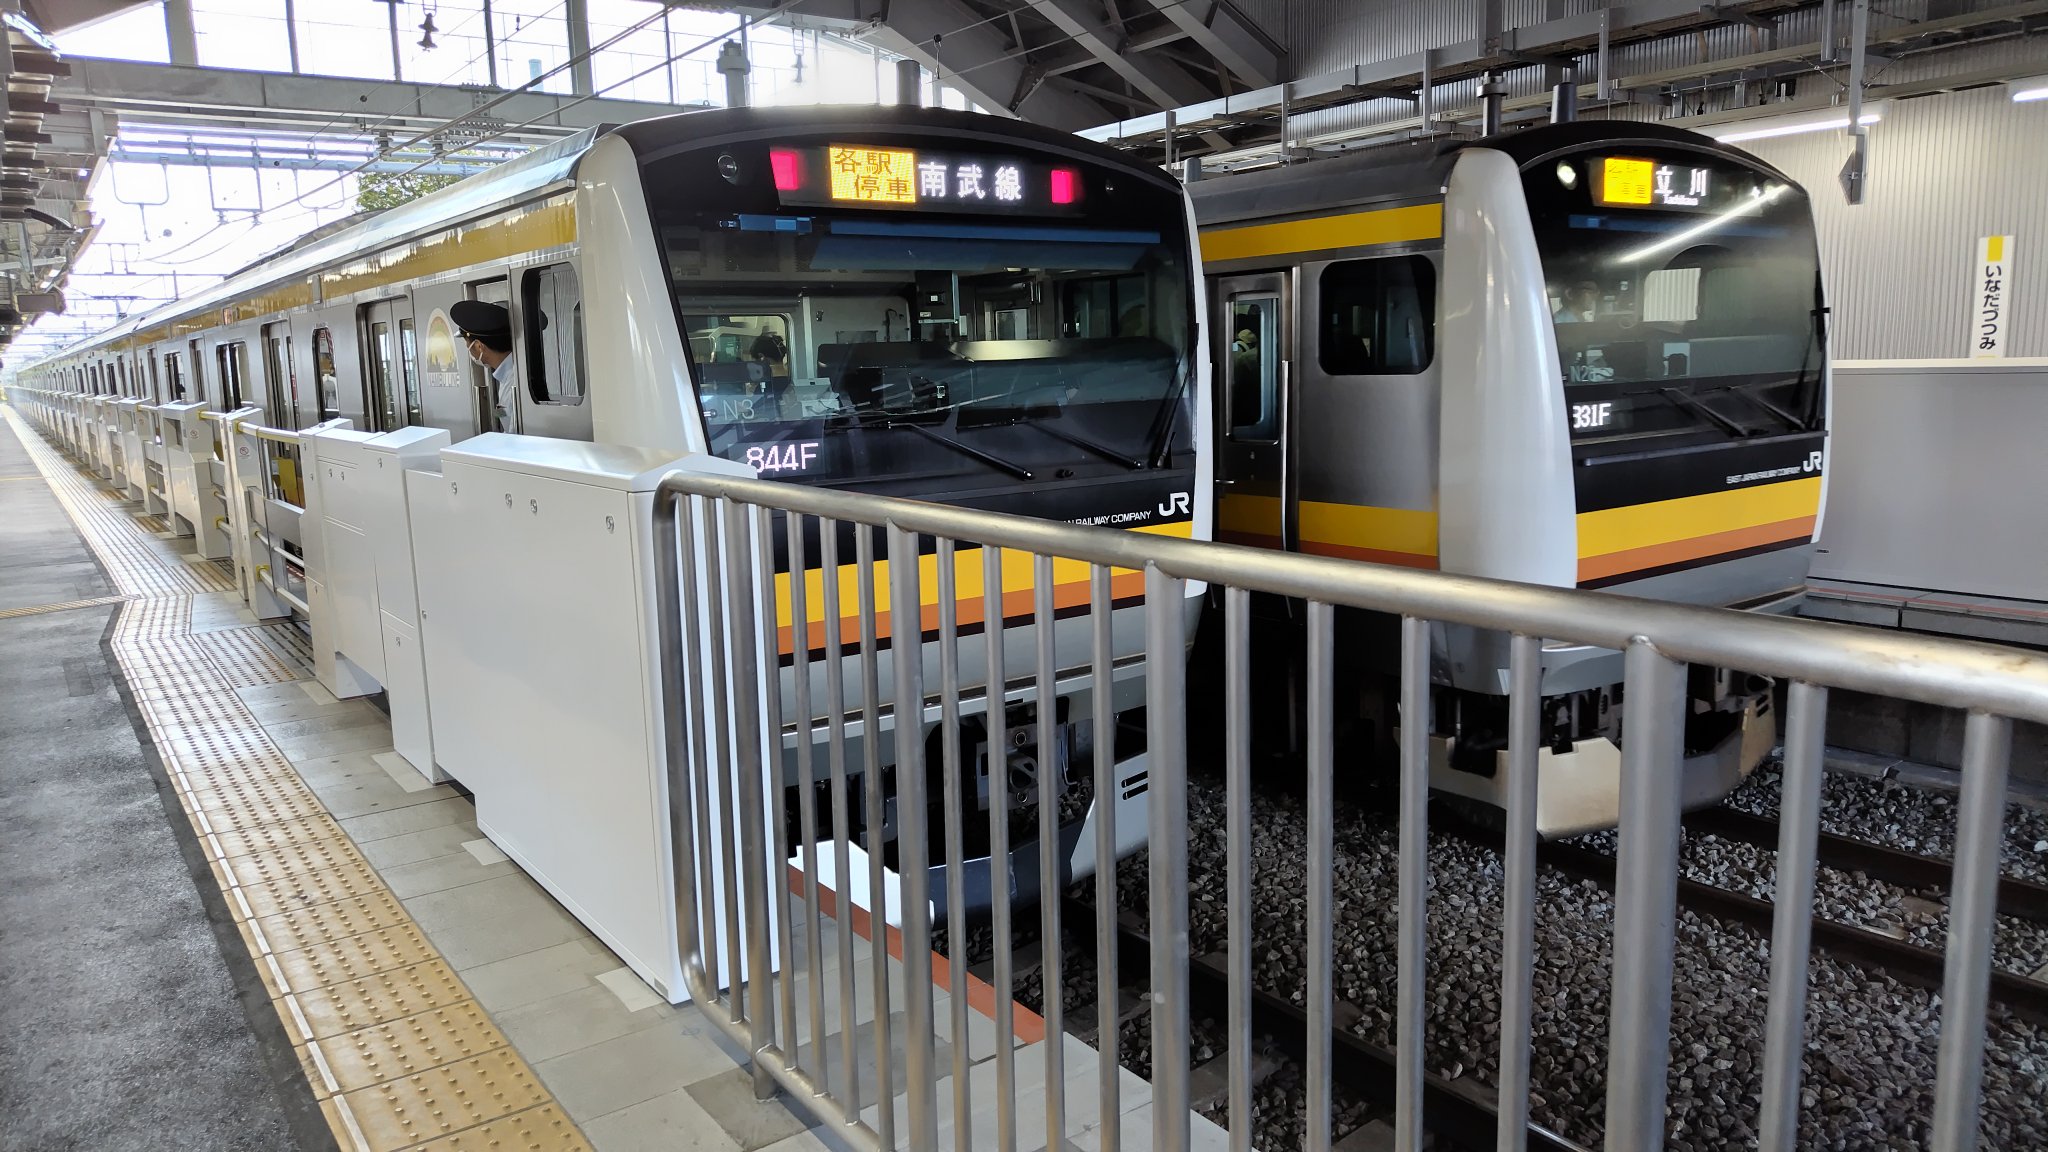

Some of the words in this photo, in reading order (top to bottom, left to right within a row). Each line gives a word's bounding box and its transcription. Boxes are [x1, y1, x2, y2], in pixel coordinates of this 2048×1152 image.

[834, 147, 892, 175] 各駅
[854, 174, 912, 200] 停車
[917, 161, 1022, 200] 南武線
[1654, 165, 1708, 197] 立川
[1978, 265, 2002, 350] いなだづつみ
[723, 399, 756, 421] N3
[746, 442, 819, 473] 844F
[1803, 451, 1822, 472] JR
[1158, 491, 1190, 517] JR
[1075, 514, 1111, 526] RAILWAY
[1111, 510, 1152, 523] COMPANY
